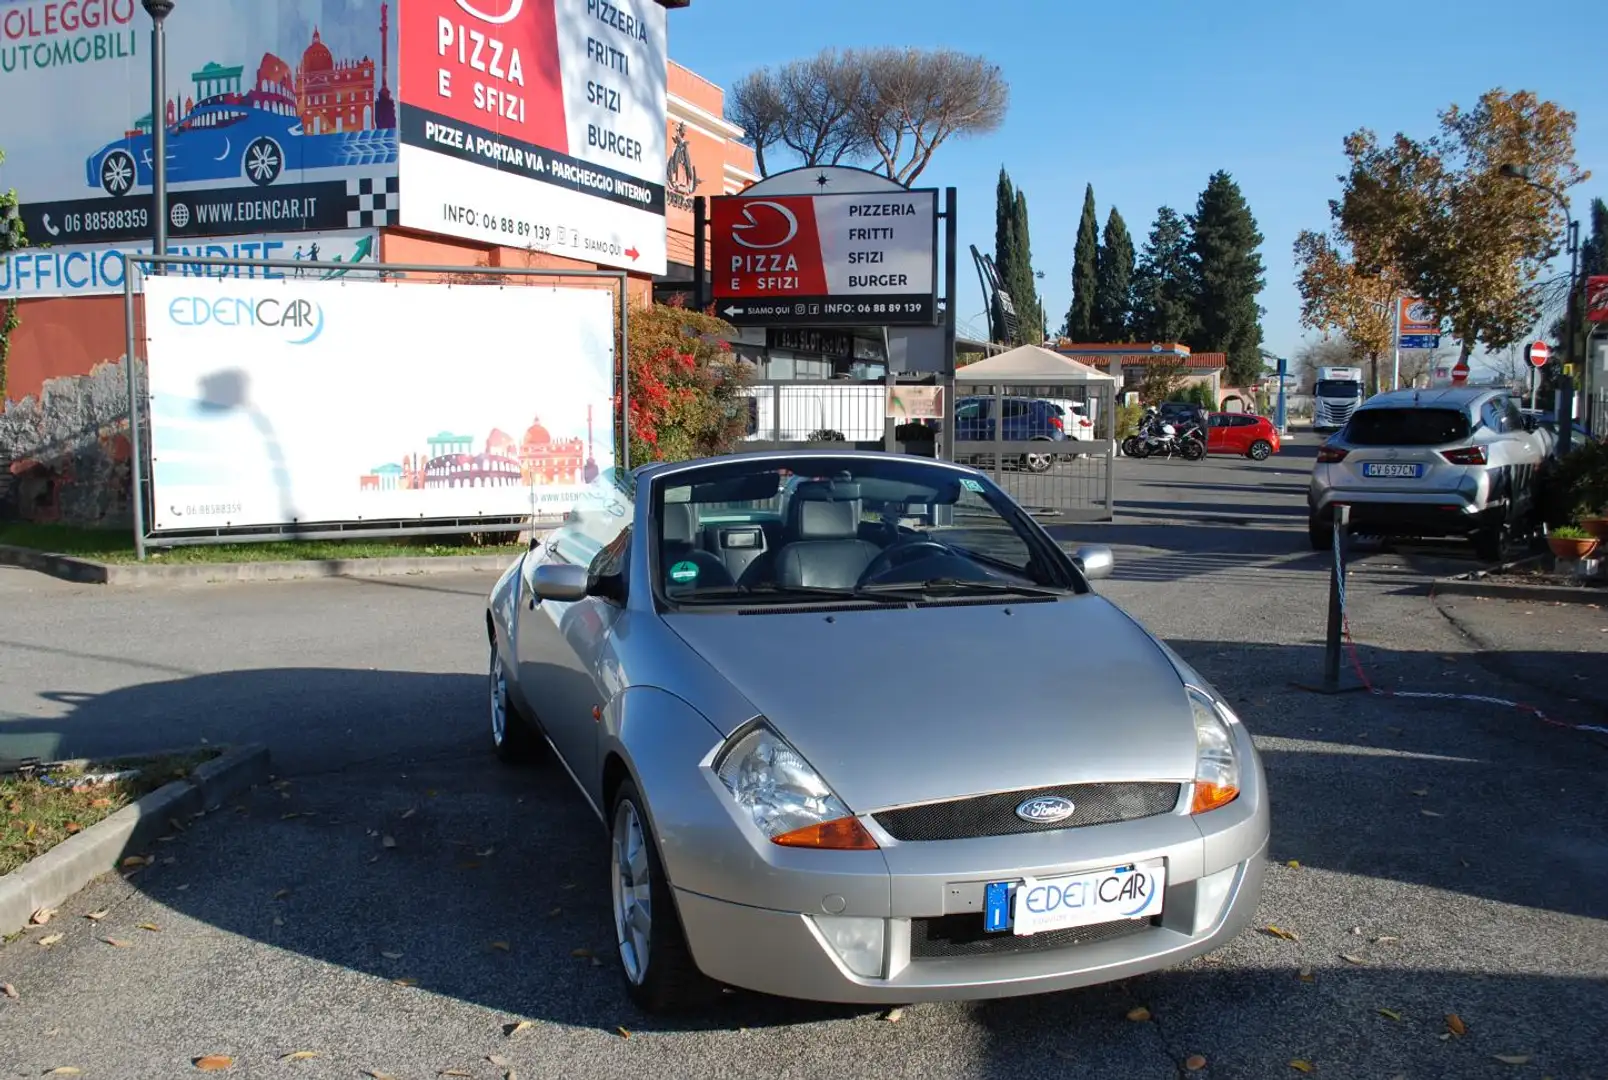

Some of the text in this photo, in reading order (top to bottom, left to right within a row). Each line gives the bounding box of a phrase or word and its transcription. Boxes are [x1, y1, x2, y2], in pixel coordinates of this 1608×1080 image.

[0, 0, 135, 39] OLEGGIO
[587, 0, 648, 44] PIZZERIA
[0, 30, 135, 72] UTOMOBILI
[437, 16, 525, 87] PIZZA
[587, 37, 629, 76] FRITTI
[438, 68, 525, 123] E SFIZI
[587, 80, 621, 114] SFIZI
[587, 124, 642, 162] BURGER
[425, 121, 463, 151] PIZZE
[465, 132, 474, 153] A
[476, 135, 524, 166] PORTAR
[525, 150, 545, 172] VIA
[552, 160, 613, 192] PARCHEGGIO
[614, 180, 651, 204] INTERNO
[64, 208, 148, 232] 06 88588359
[195, 198, 317, 224] WWW.EDENCAR.IT
[443, 203, 551, 241] INFO: 06 88 89 139
[849, 204, 916, 217] PIZZERIA
[584, 237, 621, 256] SIAMO QUI
[848, 227, 893, 240] FRITTI
[0, 250, 126, 291] UFFICIO
[731, 254, 798, 272] PIZZA
[848, 252, 884, 264] SFIZI
[731, 276, 799, 290] E SFIZI
[848, 274, 908, 287] BURGER
[168, 297, 314, 327] EDENCAR
[748, 303, 922, 316] SIAMO QUI INFO: 06 88 89 139
[185, 504, 197, 515] 06
[1031, 800, 1064, 817] Ford
[1025, 872, 1147, 914] EDENCAR
